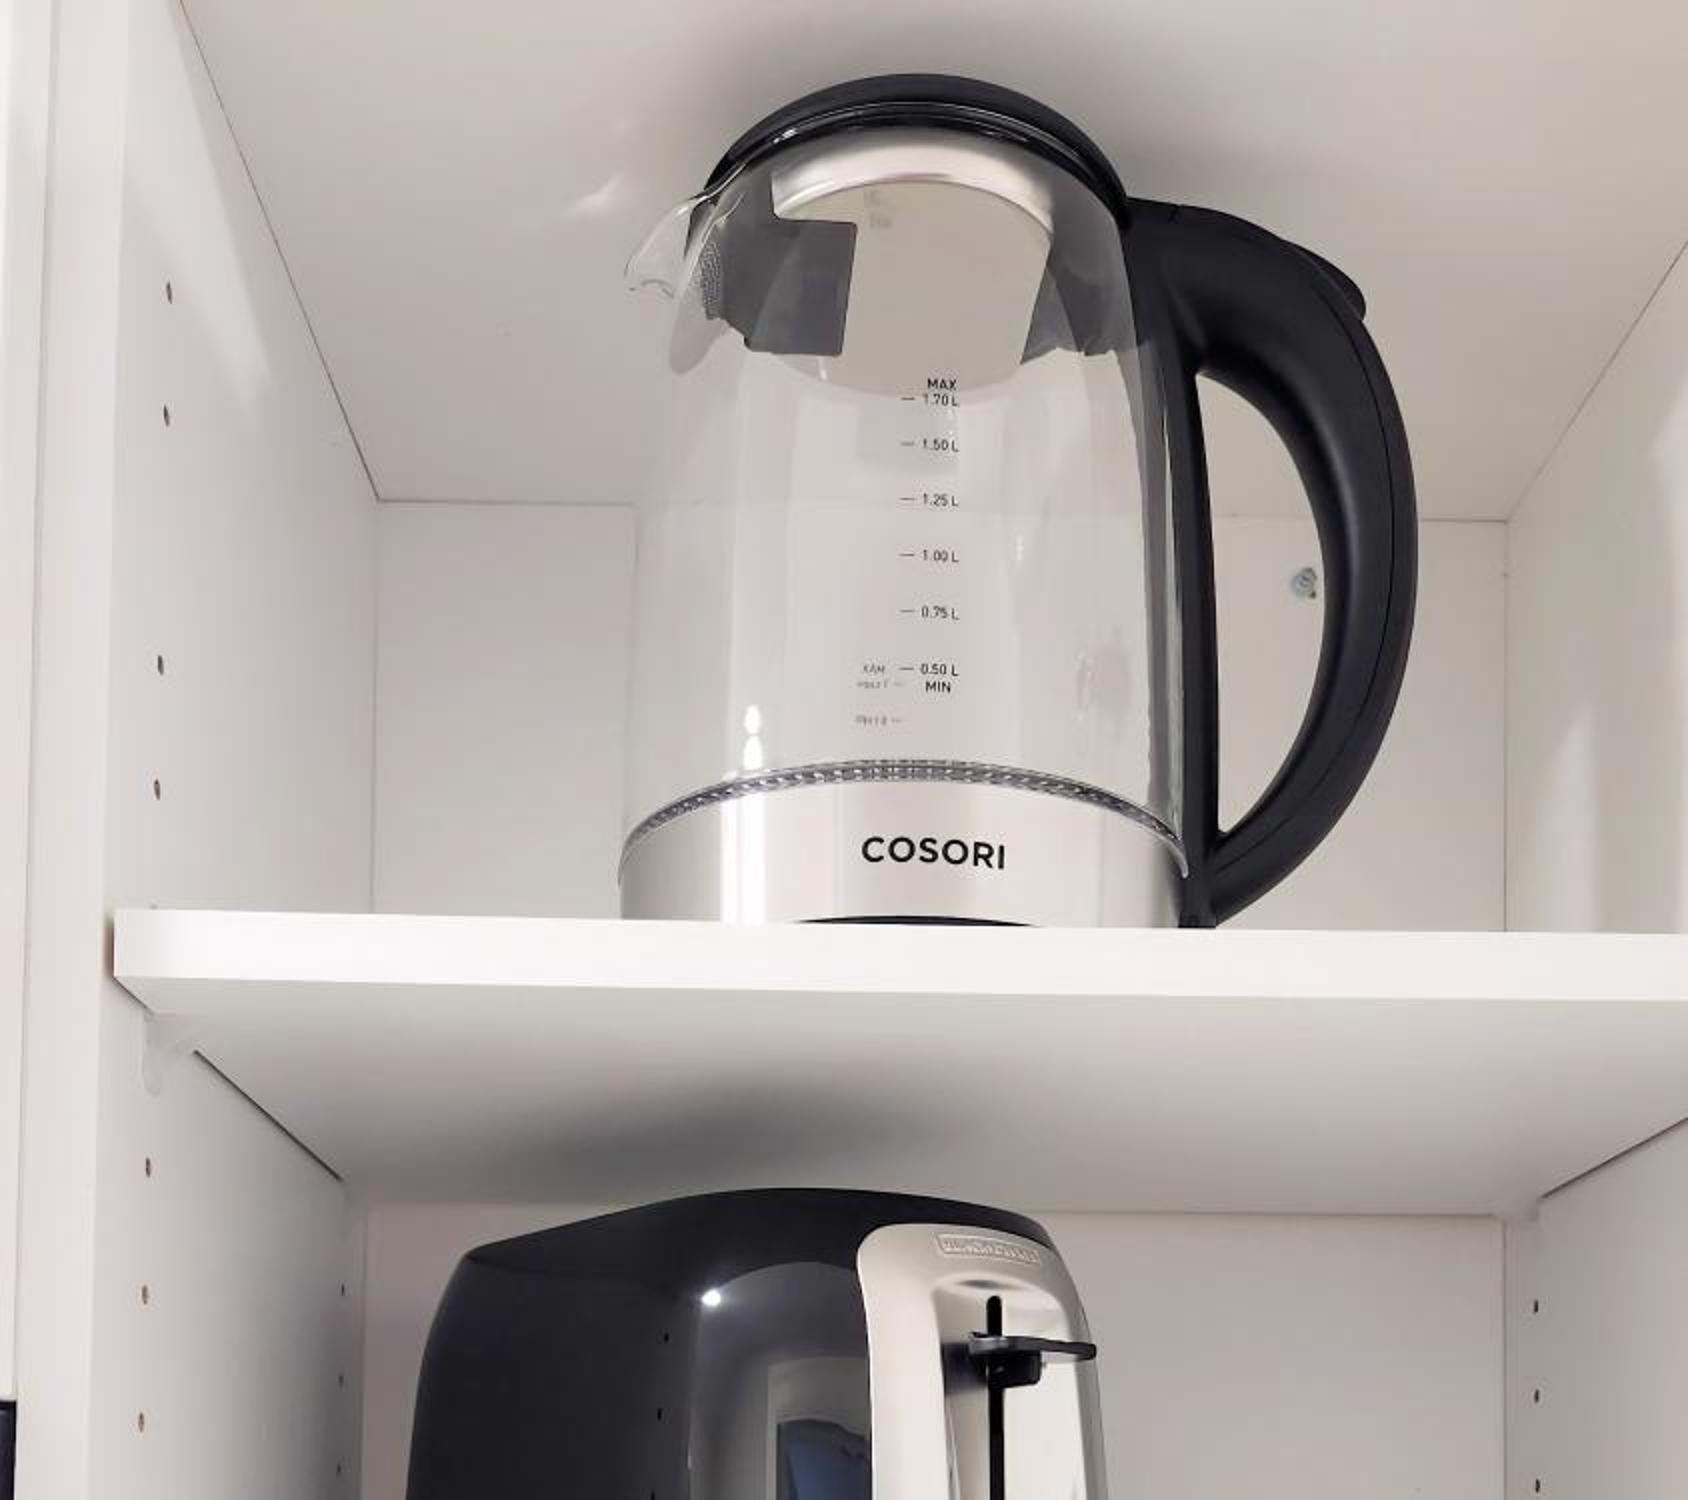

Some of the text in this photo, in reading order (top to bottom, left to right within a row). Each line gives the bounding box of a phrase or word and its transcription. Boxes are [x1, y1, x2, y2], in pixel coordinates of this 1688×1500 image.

[927, 377, 958, 391] MAX
[922, 393, 949, 406] 1.70
[922, 438, 949, 451] 1.50
[922, 493, 949, 507] 1.25
[922, 549, 949, 562] 1.00
[921, 605, 949, 619] 0.75
[920, 663, 947, 675] 0.50
[925, 681, 951, 694] MIN
[861, 836, 1005, 869] COSORI
